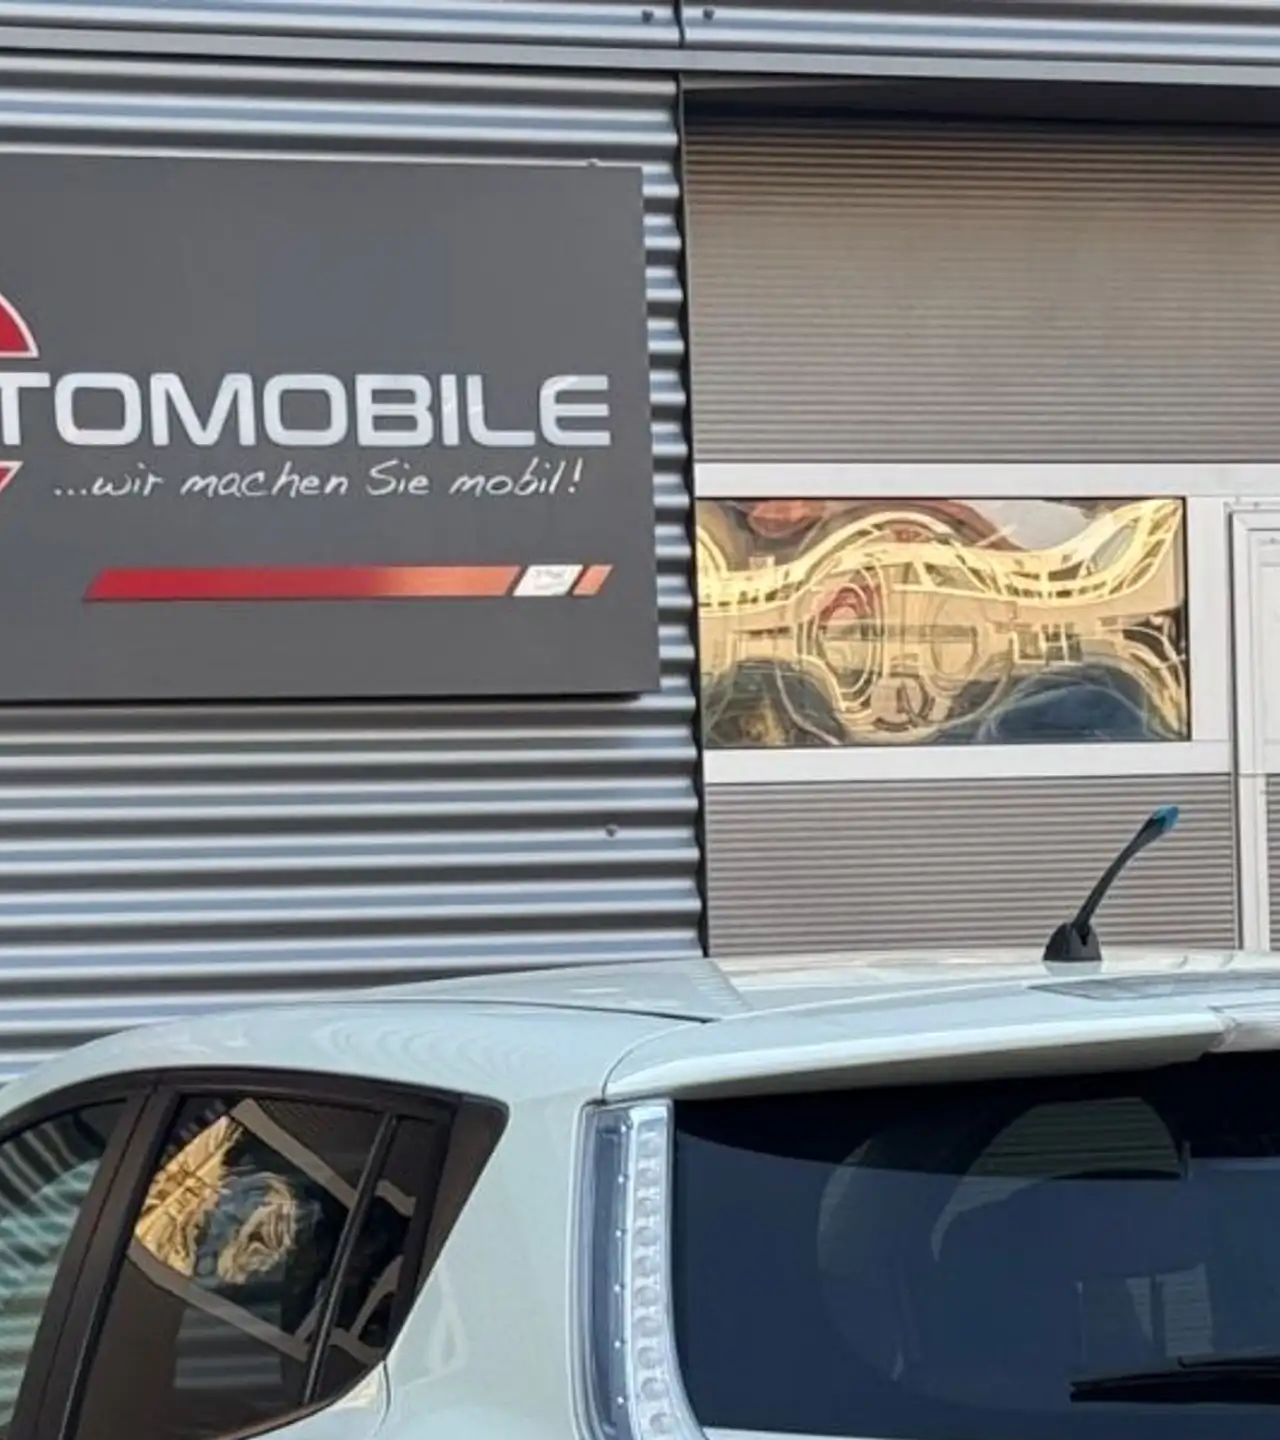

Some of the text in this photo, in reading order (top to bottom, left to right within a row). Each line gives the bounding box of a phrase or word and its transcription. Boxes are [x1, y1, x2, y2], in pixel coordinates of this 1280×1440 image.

[54, 457, 584, 498] ...wir machen Sie mobil!
